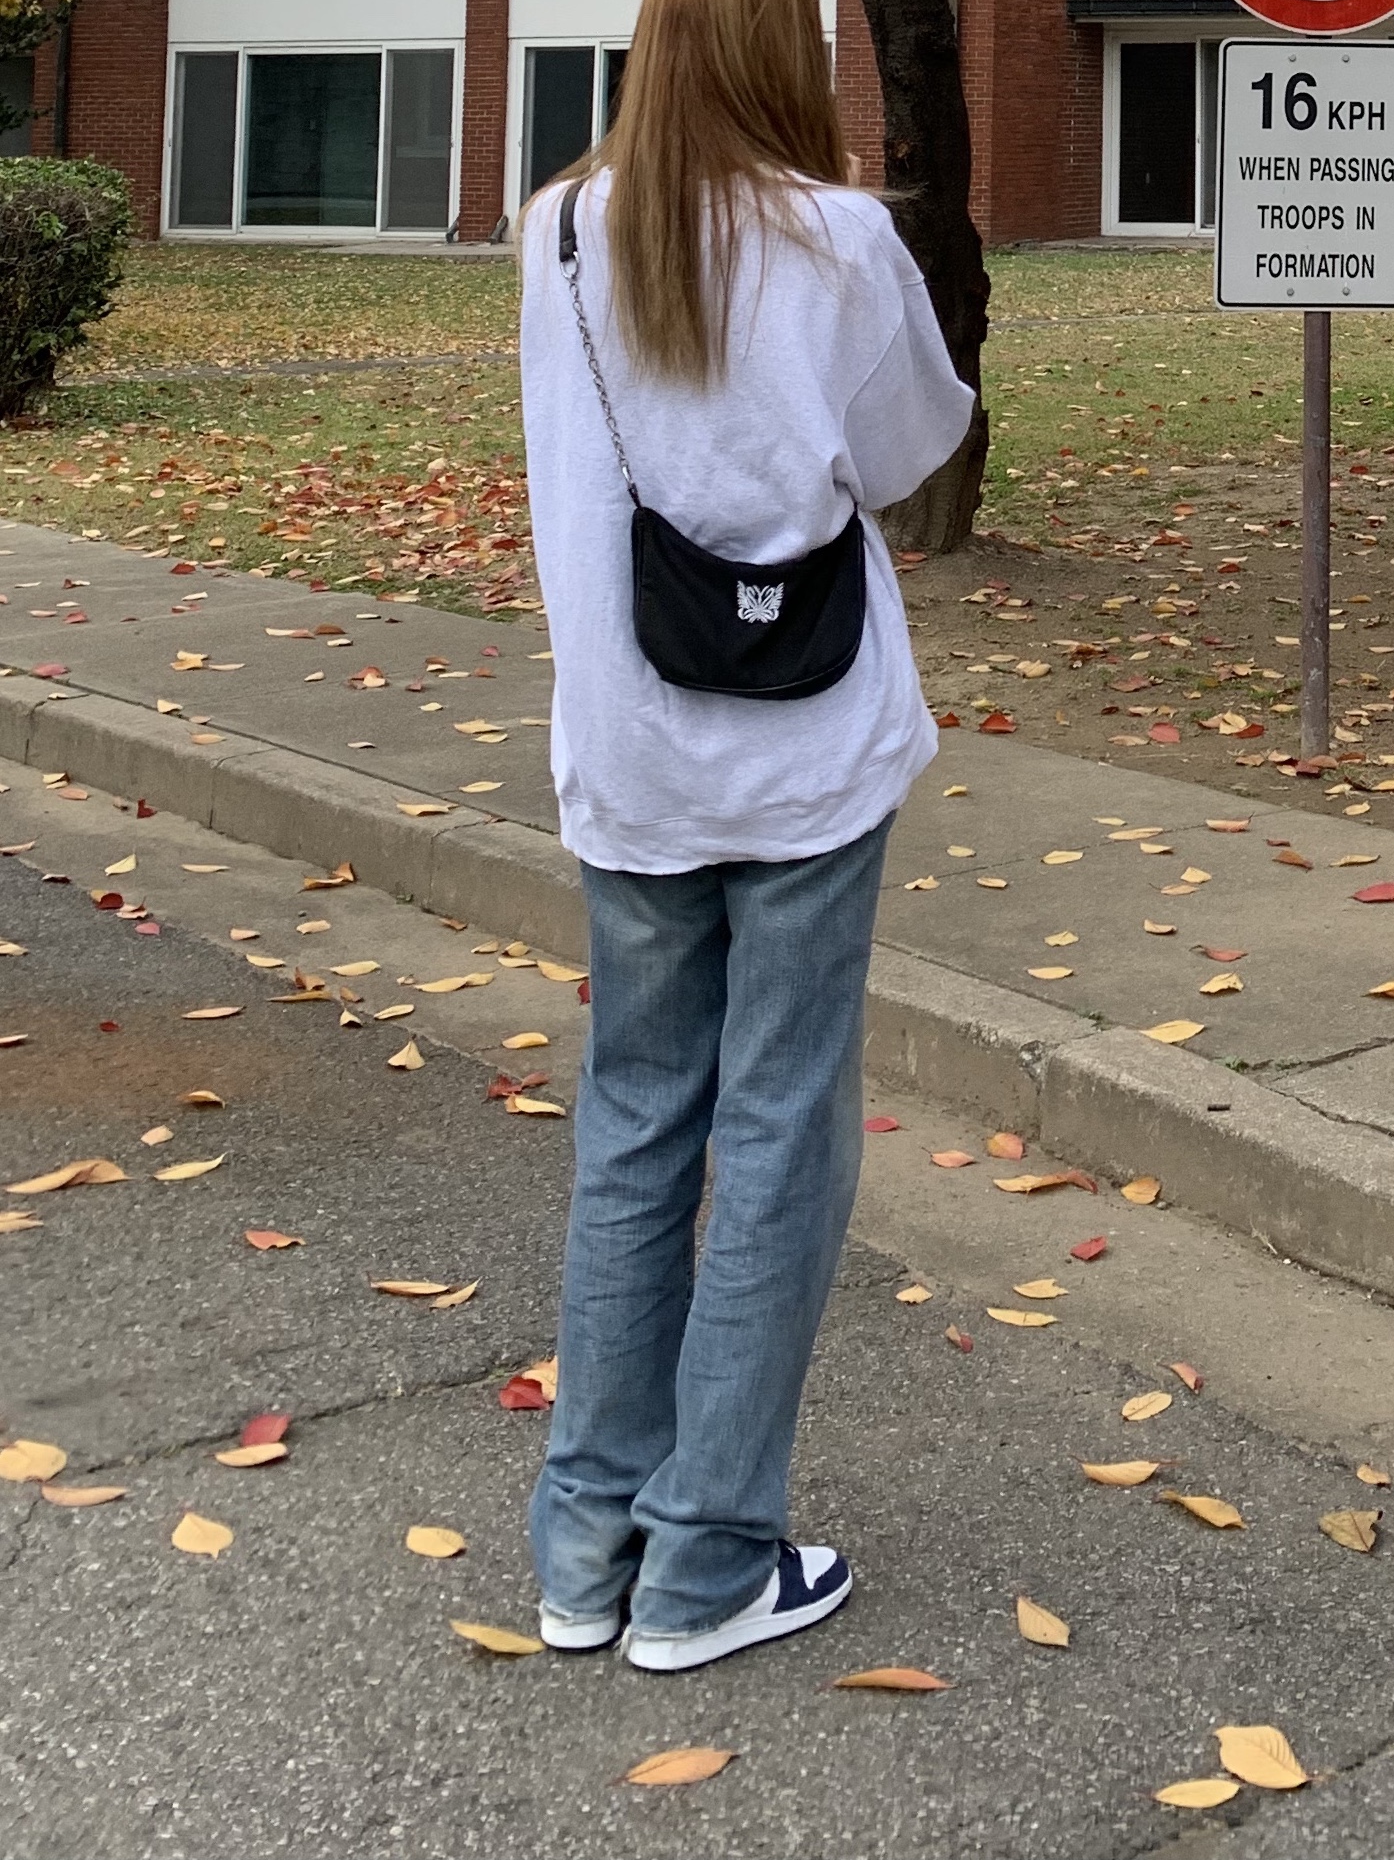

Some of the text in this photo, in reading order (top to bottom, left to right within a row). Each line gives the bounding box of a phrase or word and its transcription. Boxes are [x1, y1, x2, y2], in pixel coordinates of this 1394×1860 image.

[1251, 72, 1386, 131] 16 KPH
[1239, 156, 1394, 183] WHEN PASSING
[1257, 204, 1375, 231] TROOPS IN
[1256, 253, 1375, 279] FORMATION
